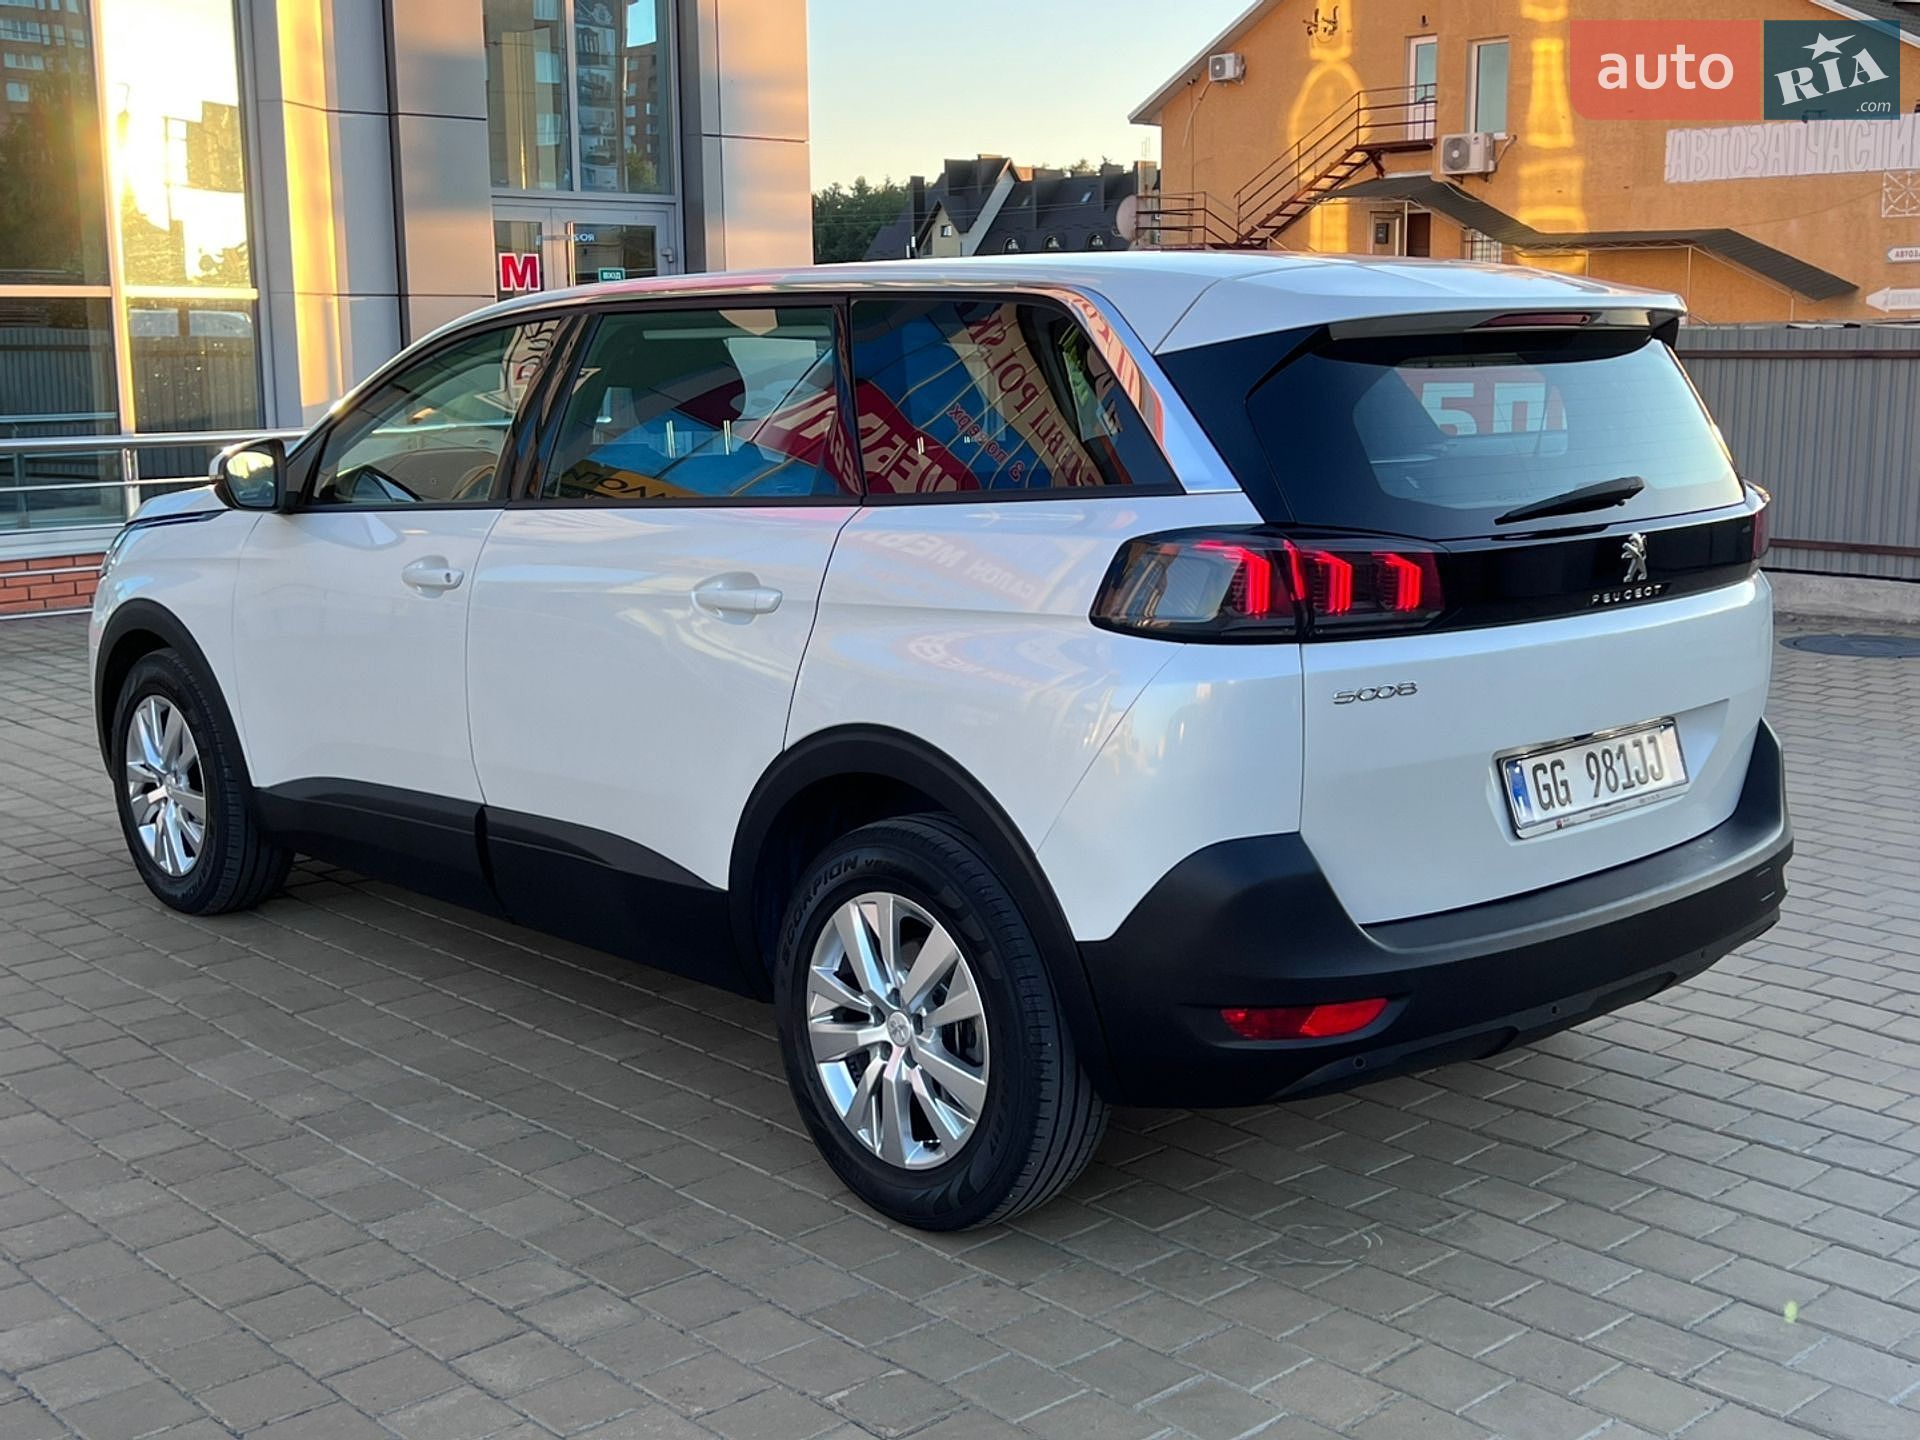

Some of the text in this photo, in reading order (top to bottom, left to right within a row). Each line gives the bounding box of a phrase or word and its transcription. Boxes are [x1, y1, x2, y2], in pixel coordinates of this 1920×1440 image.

[1591, 584, 1662, 605] PEUGEOT
[1332, 680, 1418, 705] 5008
[1532, 758, 1572, 811] GG
[1585, 735, 1664, 798] 981JJ
